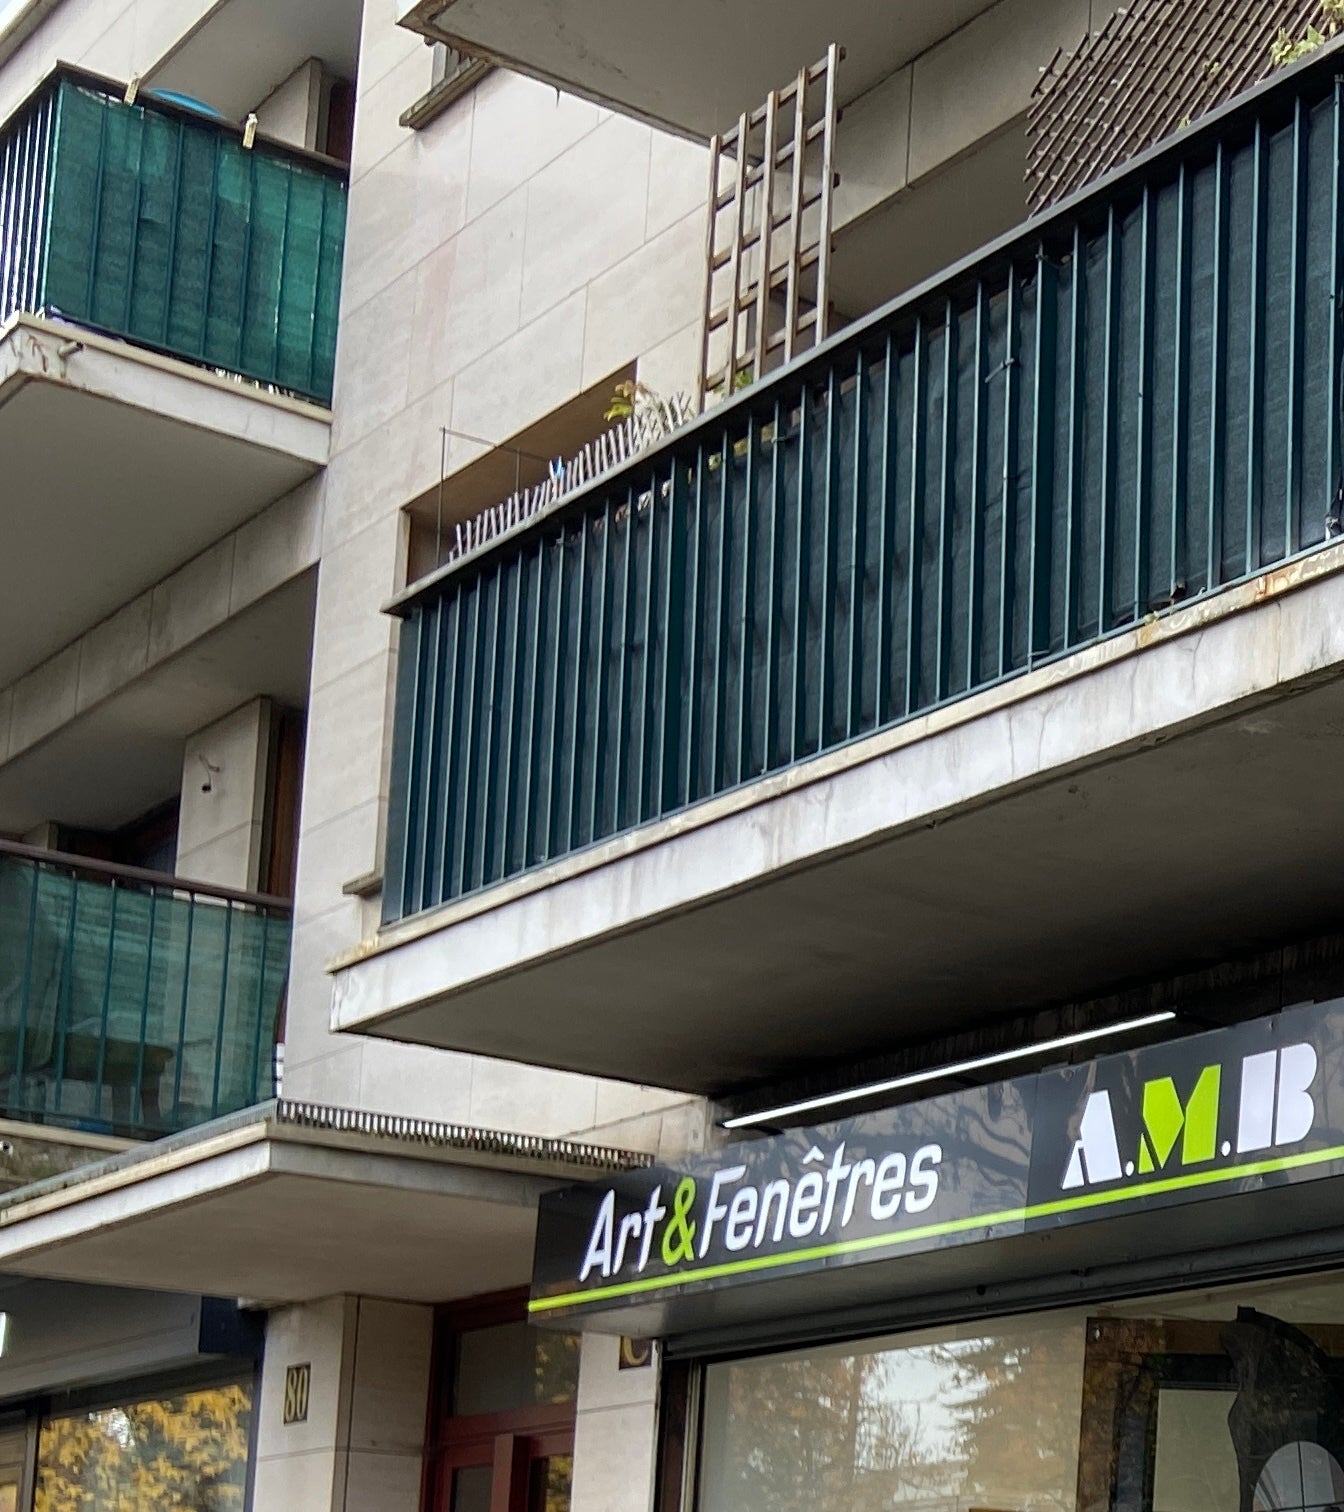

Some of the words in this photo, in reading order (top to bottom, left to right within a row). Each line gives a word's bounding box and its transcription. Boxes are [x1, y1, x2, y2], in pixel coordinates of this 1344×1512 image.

[1061, 1042, 1319, 1190] A.M.B
[578, 1141, 943, 1282] Art&Fenêtres
[284, 1366, 308, 1422] 80
